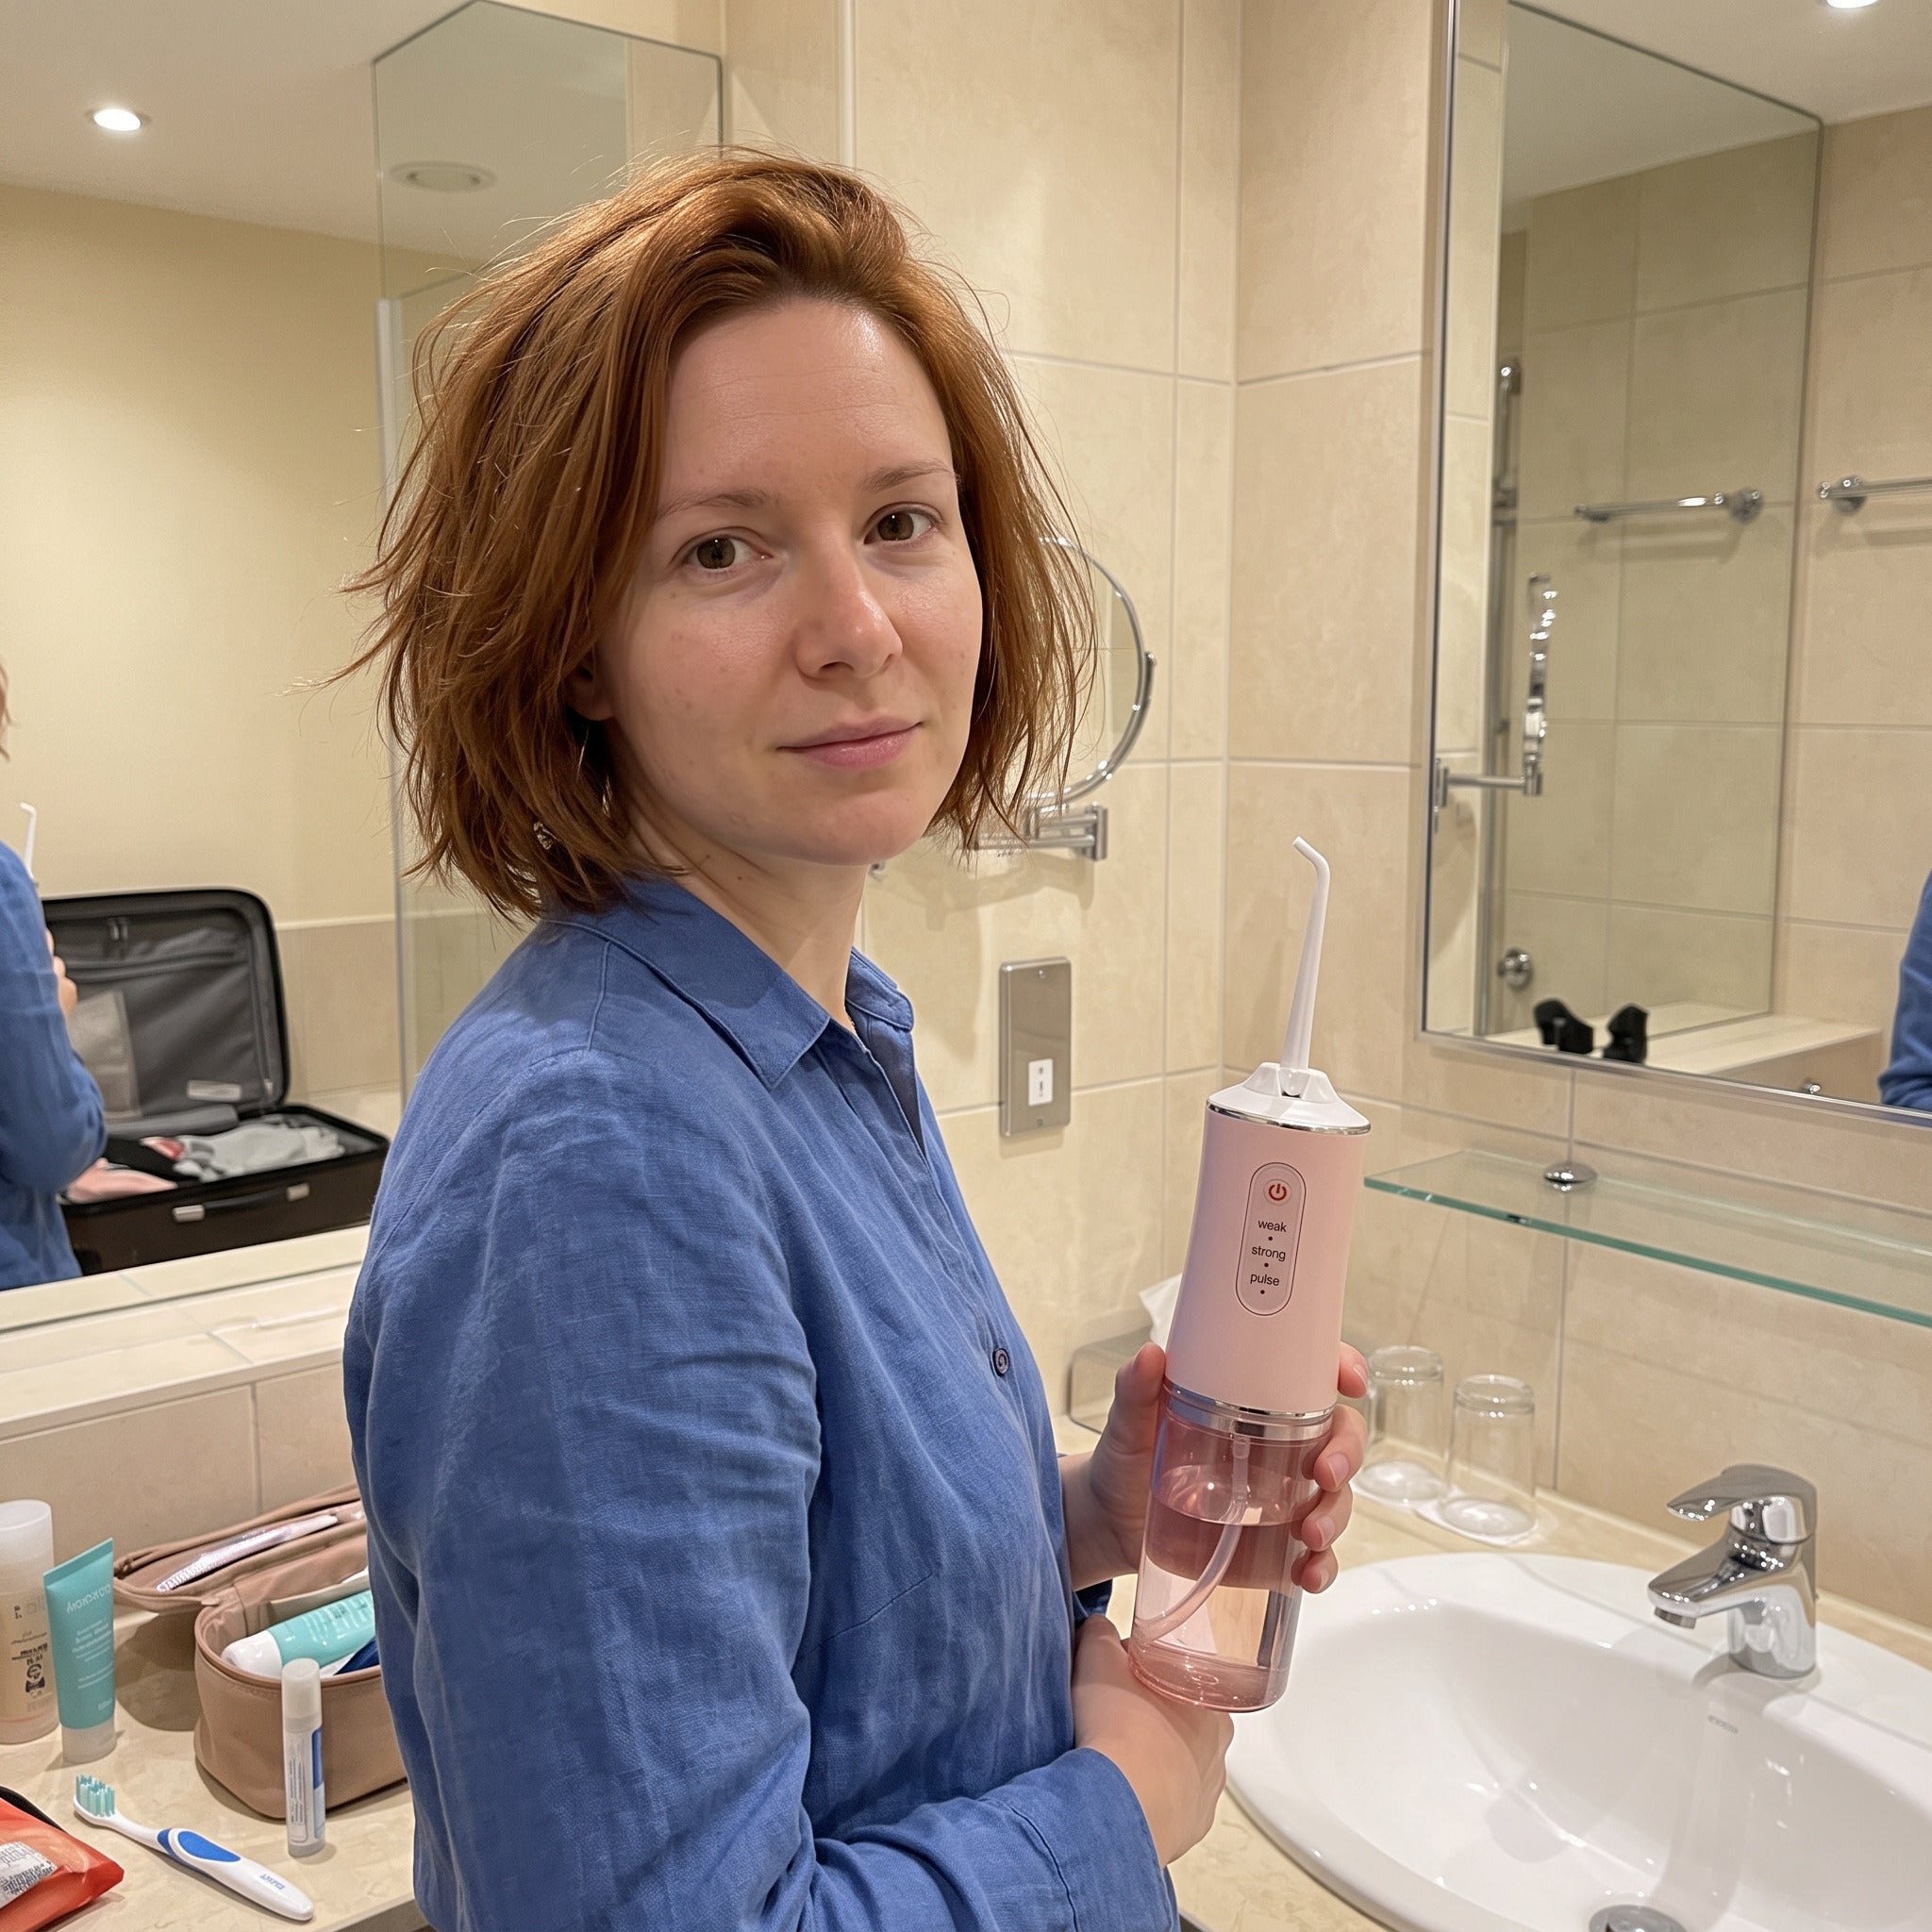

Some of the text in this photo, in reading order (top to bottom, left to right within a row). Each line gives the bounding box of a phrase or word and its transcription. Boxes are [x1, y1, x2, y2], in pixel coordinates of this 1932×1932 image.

[1257, 1220, 1287, 1232] weak
[1251, 1245, 1286, 1261] strong
[1250, 1274, 1280, 1286] pulse
